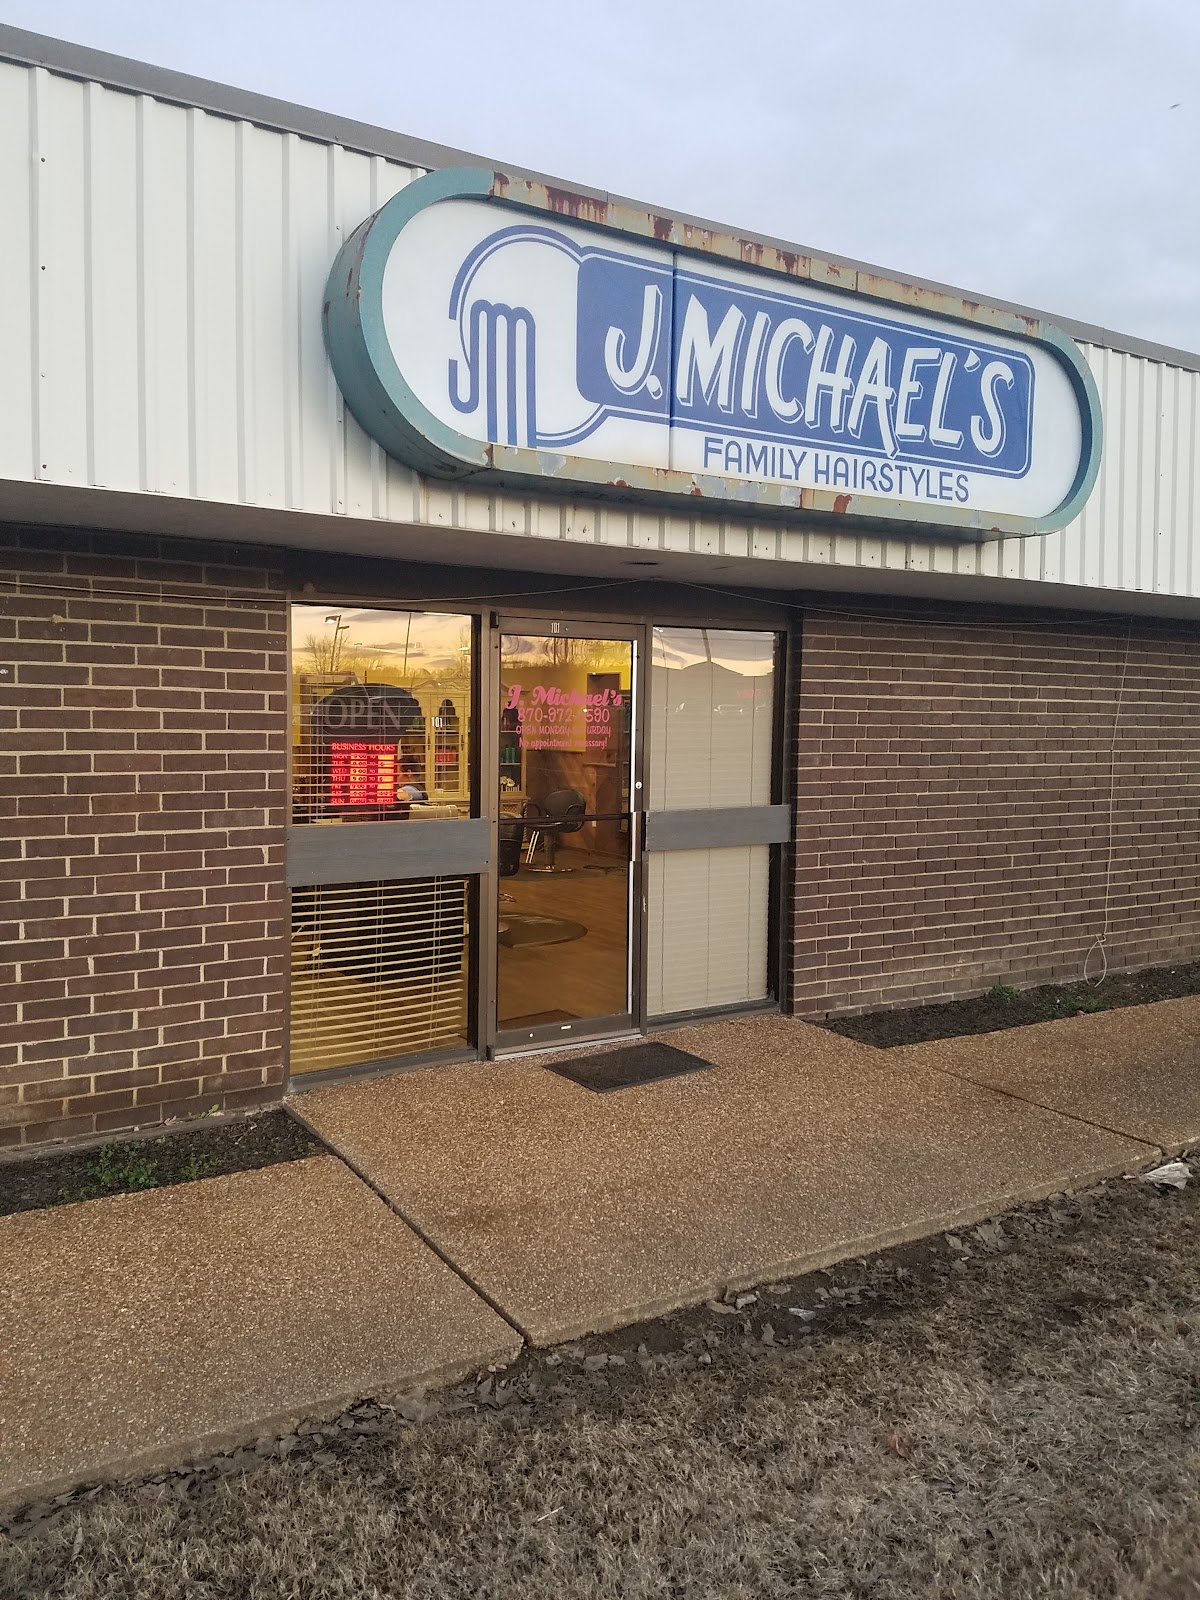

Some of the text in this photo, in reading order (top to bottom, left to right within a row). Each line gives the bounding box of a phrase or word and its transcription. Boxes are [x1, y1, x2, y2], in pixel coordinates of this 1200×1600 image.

[704, 436, 970, 503] FAMILY HAIRSTYLES
[551, 622, 560, 634] 101
[505, 684, 623, 709] J. Michael's
[324, 697, 402, 730] OPEN
[517, 707, 610, 723] 870-972-0590
[516, 725, 537, 735] OPEN
[331, 742, 367, 751] BUSINESS
[518, 737, 529, 748] No
